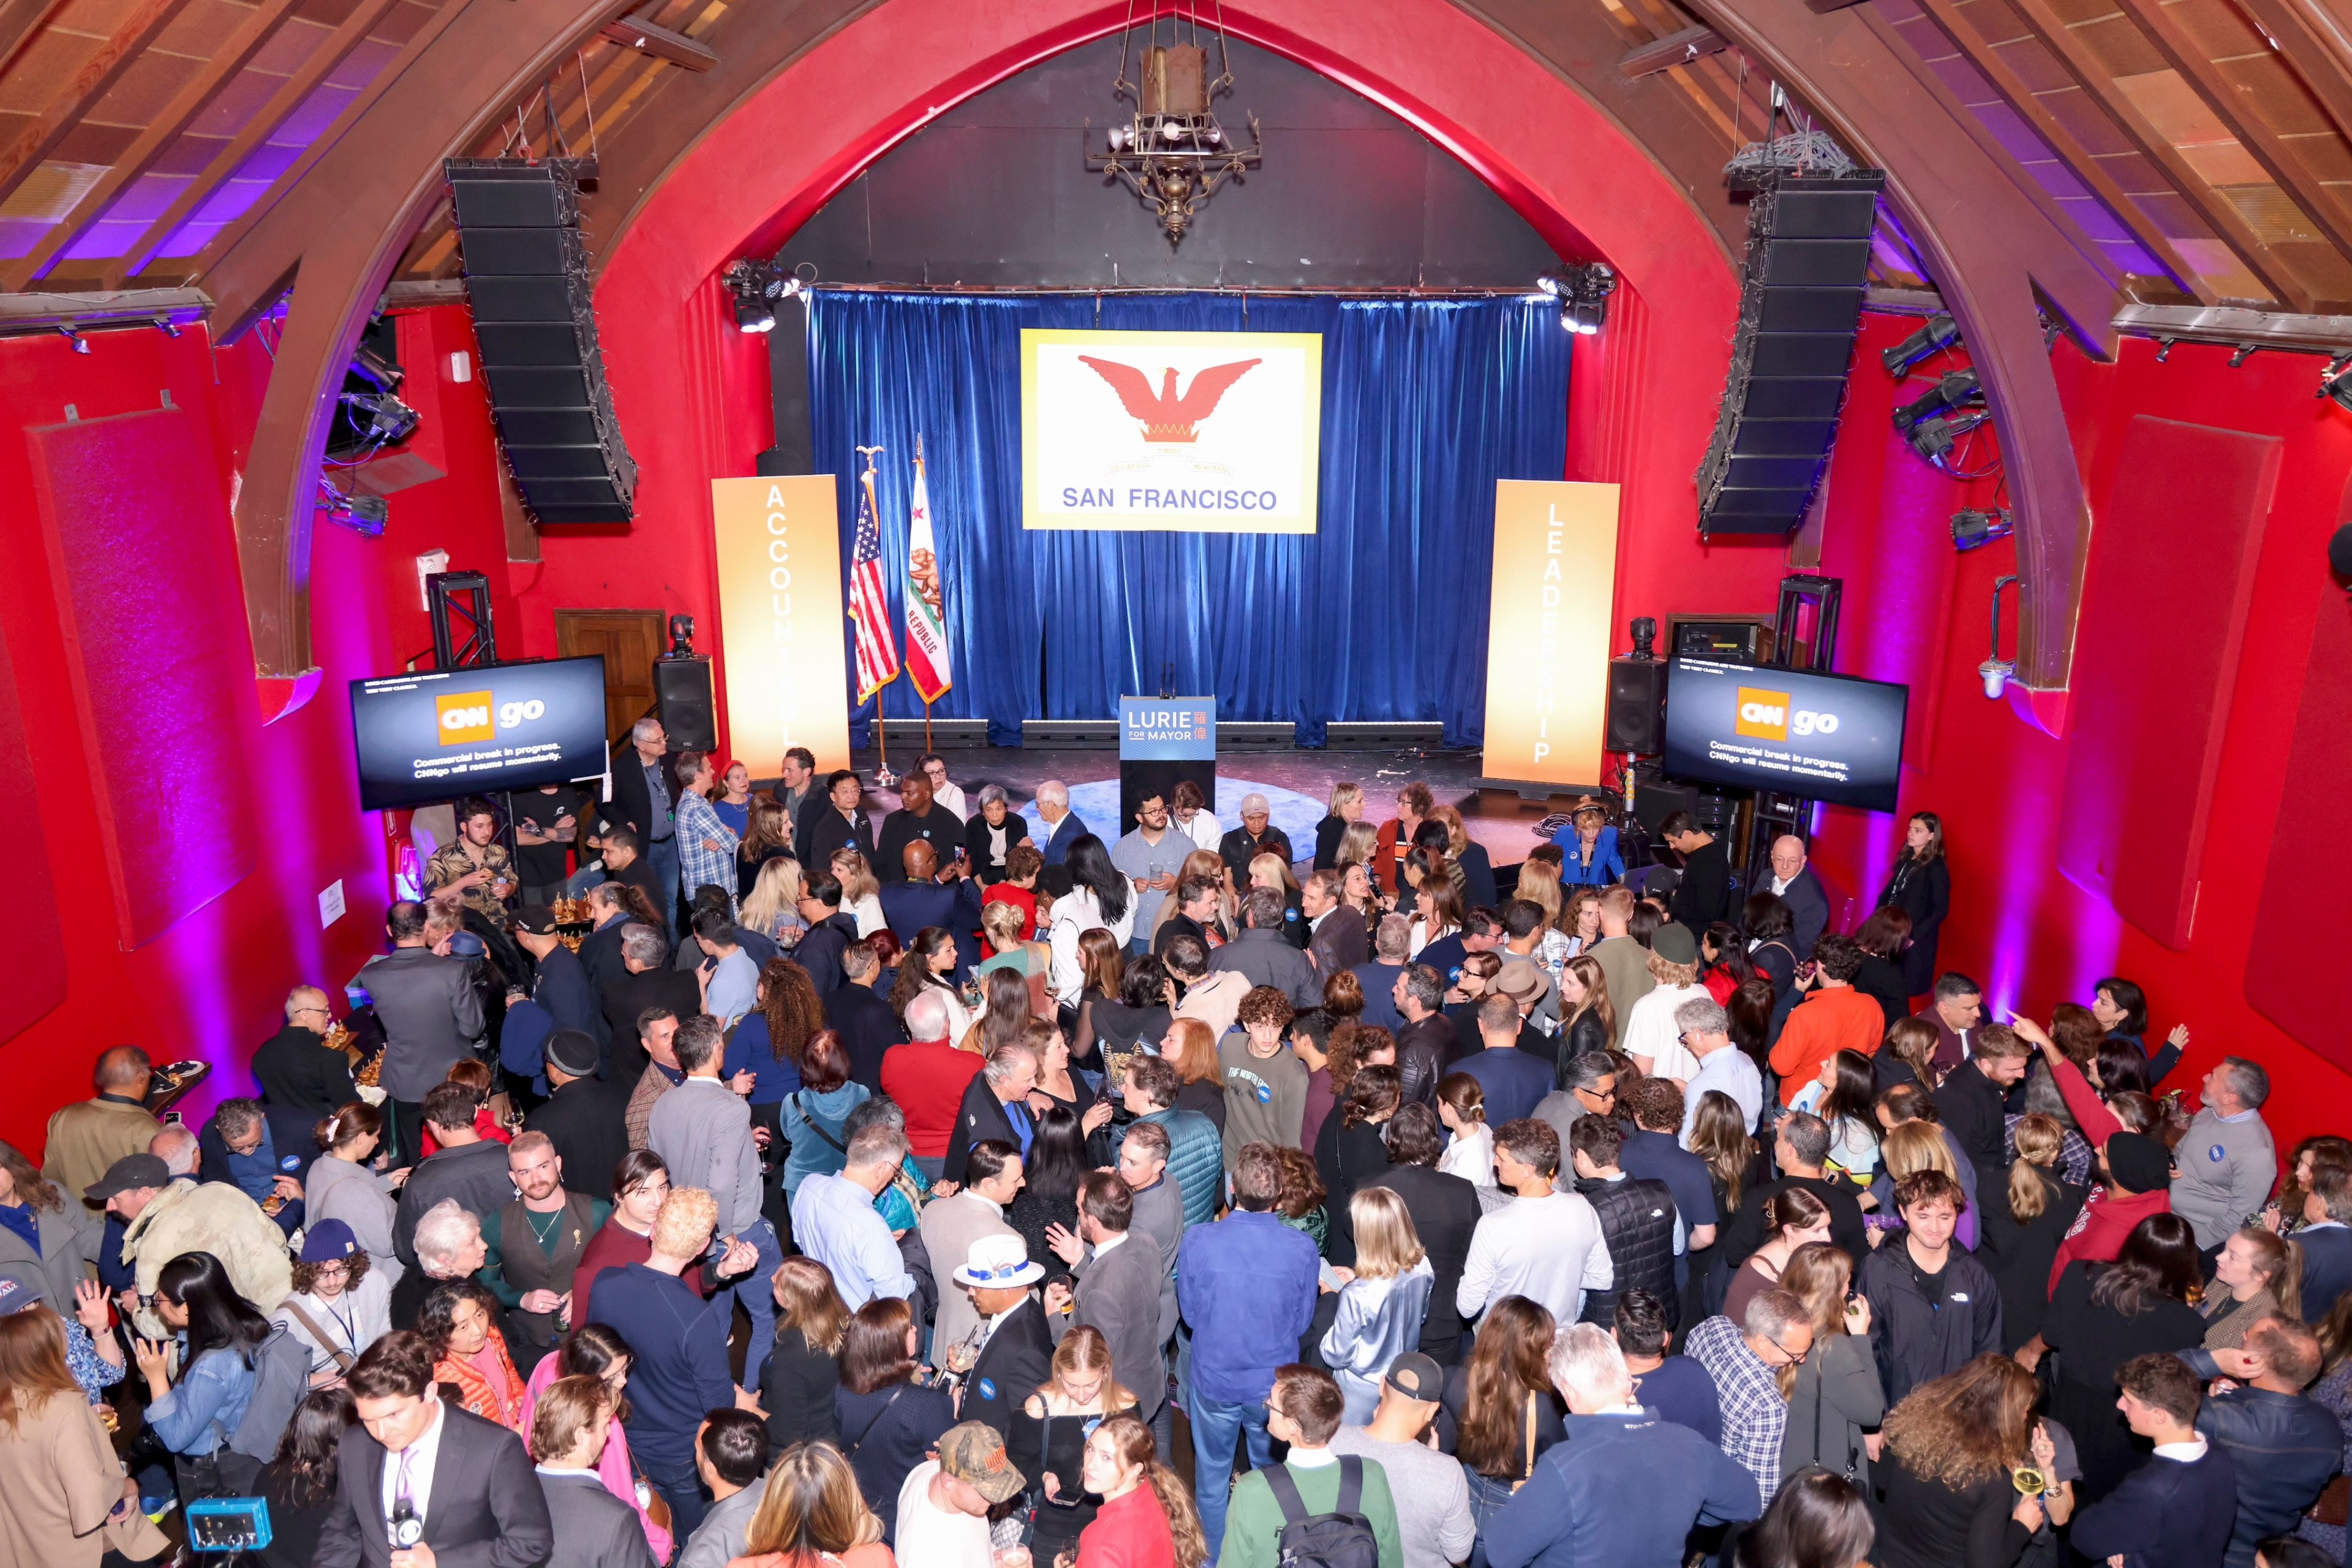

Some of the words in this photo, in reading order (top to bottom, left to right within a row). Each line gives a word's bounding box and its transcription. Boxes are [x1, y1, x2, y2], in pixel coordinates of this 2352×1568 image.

[1063, 488, 1114, 508] SAN
[1129, 489, 1277, 510] FRANCISCO
[908, 610, 937, 654] REPUBLIC
[1534, 503, 1564, 763] LEADERSHIP
[442, 706, 488, 729] CNN
[500, 699, 545, 728] go
[1128, 711, 1191, 728] LURIE
[1741, 703, 1784, 726] CNN
[1792, 710, 1839, 736] go
[1148, 731, 1191, 740] MAYOR
[413, 753, 472, 768] Commercial
[474, 749, 503, 760] break
[515, 742, 561, 757] progress.
[414, 768, 450, 778] CNNgo
[451, 764, 467, 774] will
[469, 761, 503, 771] resume
[505, 752, 562, 766] momentarily.
[1709, 751, 1740, 763] CNNgo
[1742, 757, 1756, 766] will
[1758, 760, 1790, 771] resume
[1792, 765, 1848, 782] momentarily.
[1710, 741, 1762, 756] Commercial
[1764, 749, 1790, 761] break
[1793, 753, 1801, 763] in
[1803, 756, 1849, 771] progress.
[1228, 1067, 1240, 1077] THE
[1240, 1069, 1259, 1085] NORTH
